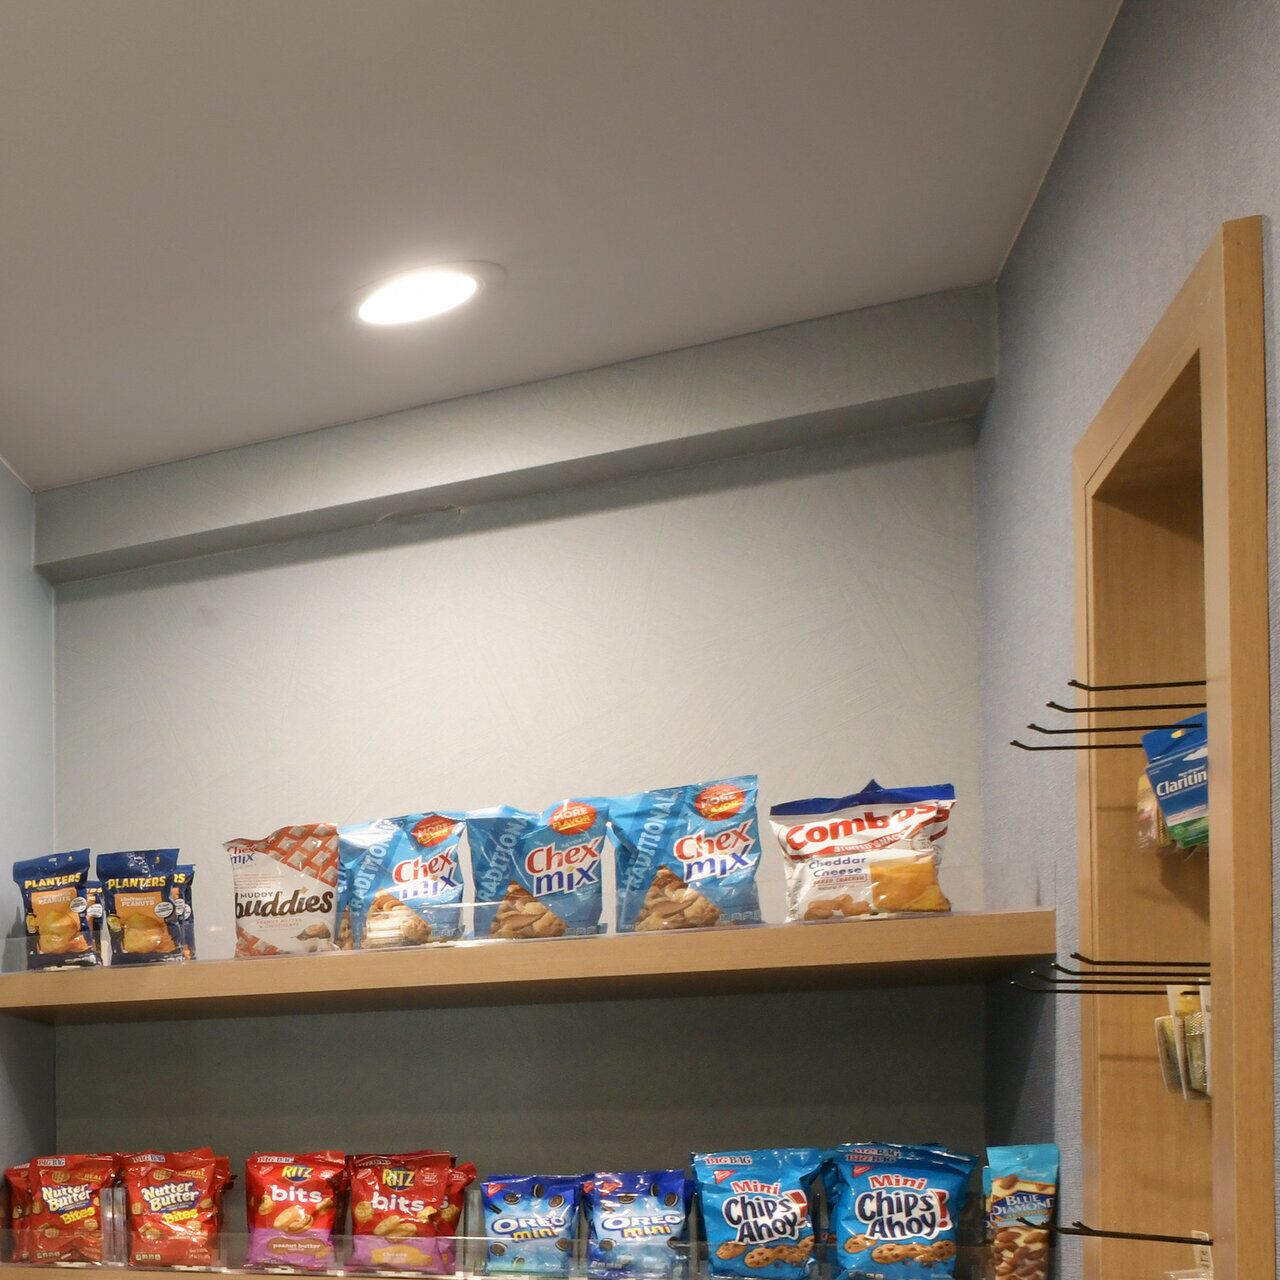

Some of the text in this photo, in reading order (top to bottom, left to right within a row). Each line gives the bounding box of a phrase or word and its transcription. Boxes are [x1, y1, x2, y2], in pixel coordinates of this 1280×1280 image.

[1156, 771, 1207, 796] Claritin
[786, 802, 939, 848] Combos
[675, 821, 754, 862] Chex
[231, 853, 254, 865] mix
[527, 838, 603, 874] Chex
[809, 856, 866, 869] Cheddar
[394, 847, 455, 883] Chex
[686, 848, 756, 882] mix
[814, 866, 861, 877] Cheese
[24, 873, 81, 888] PLANTERS
[108, 876, 166, 889] PLANTERS
[535, 860, 597, 897] mix
[236, 890, 334, 919] buddies
[729, 1155, 752, 1164] BAG
[282, 1166, 314, 1179] RITZ
[382, 1169, 415, 1187] RITZ
[731, 1180, 781, 1195] Mini
[870, 1174, 925, 1189] Mini
[42, 1184, 86, 1200] Nutter
[142, 1182, 193, 1199] Nutter
[271, 1185, 322, 1203] bits
[48, 1191, 92, 1210] Butter
[149, 1191, 199, 1209] Butter
[372, 1191, 424, 1212] bits
[859, 1192, 934, 1218] Chips
[1006, 1194, 1039, 1206] BLUE
[62, 1207, 95, 1224] Bites
[164, 1209, 199, 1223] Bites
[725, 1197, 789, 1225] Chips
[493, 1216, 565, 1233] OREO
[603, 1214, 681, 1230] OREO
[622, 1225, 672, 1238] mini
